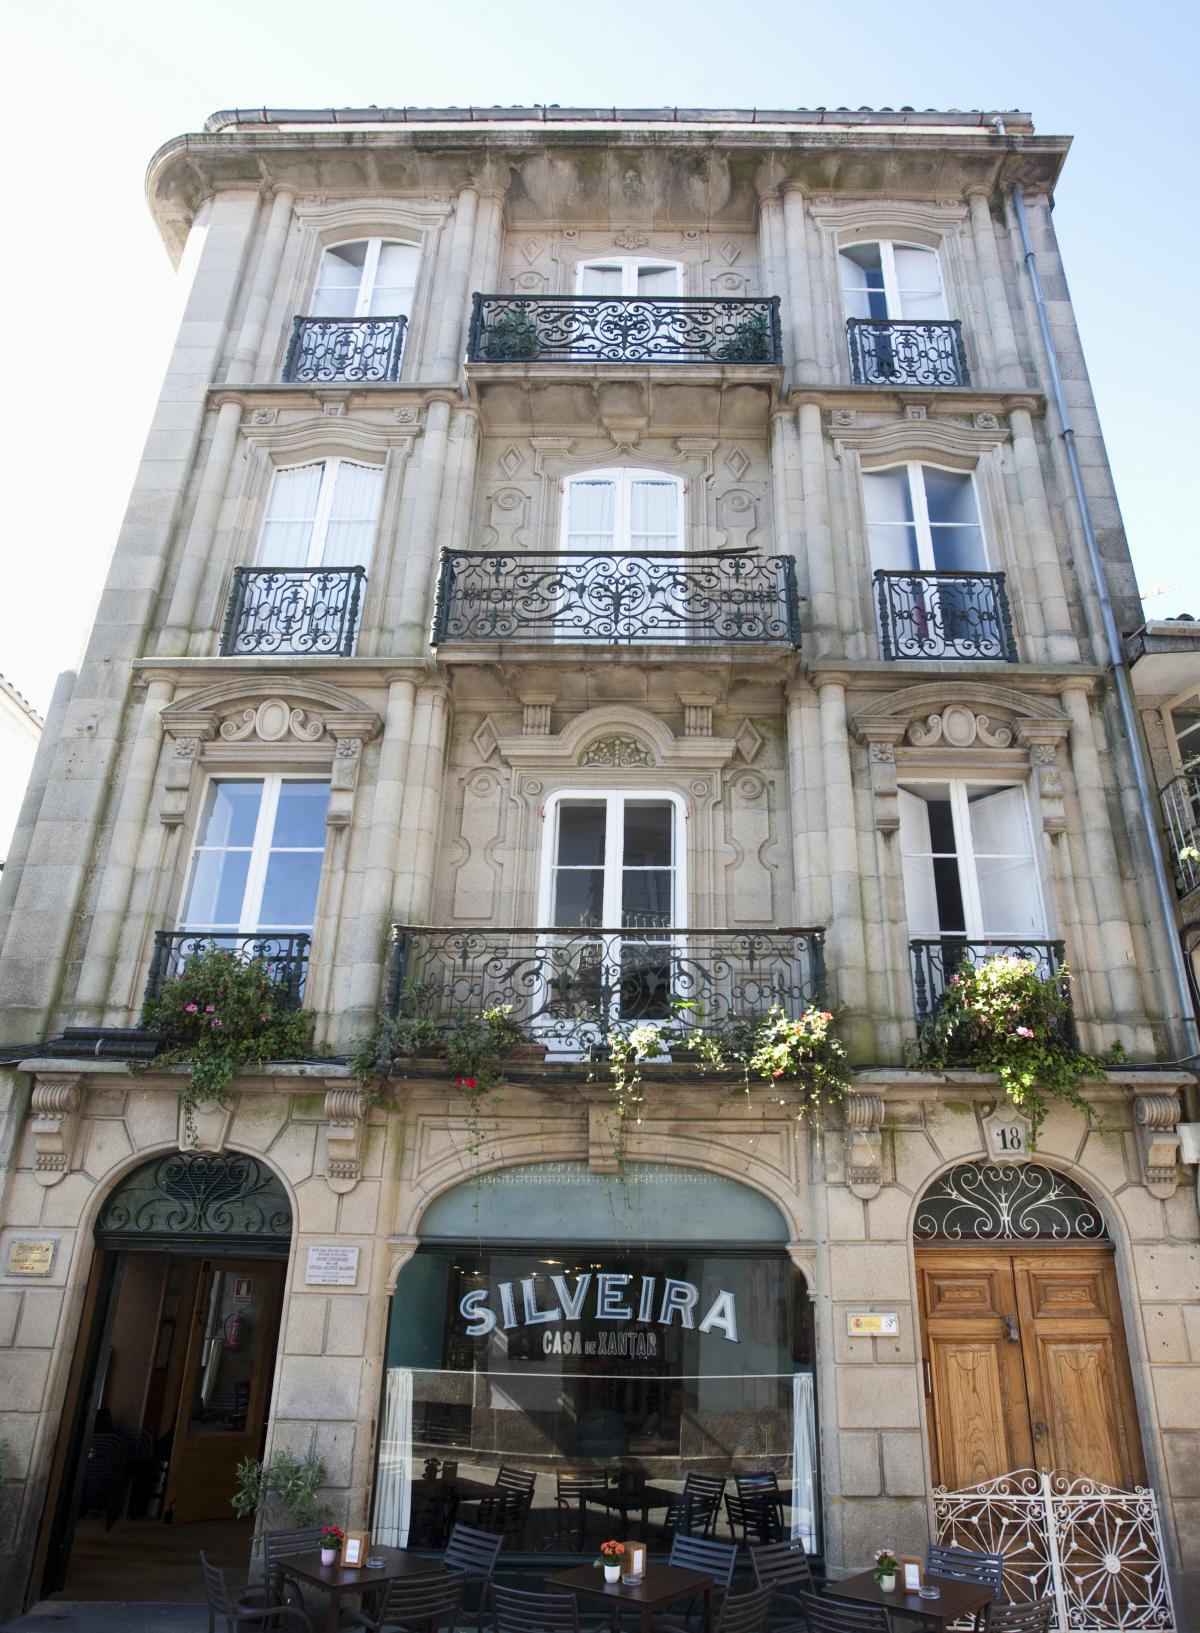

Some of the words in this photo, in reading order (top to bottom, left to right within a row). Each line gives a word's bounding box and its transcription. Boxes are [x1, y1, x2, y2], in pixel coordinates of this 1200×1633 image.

[996, 1126, 1021, 1150] 18
[459, 1273, 740, 1343] SILVEIRA
[542, 1330, 582, 1355] CASA
[585, 1340, 597, 1355] DE
[597, 1331, 657, 1356] XANTAR
